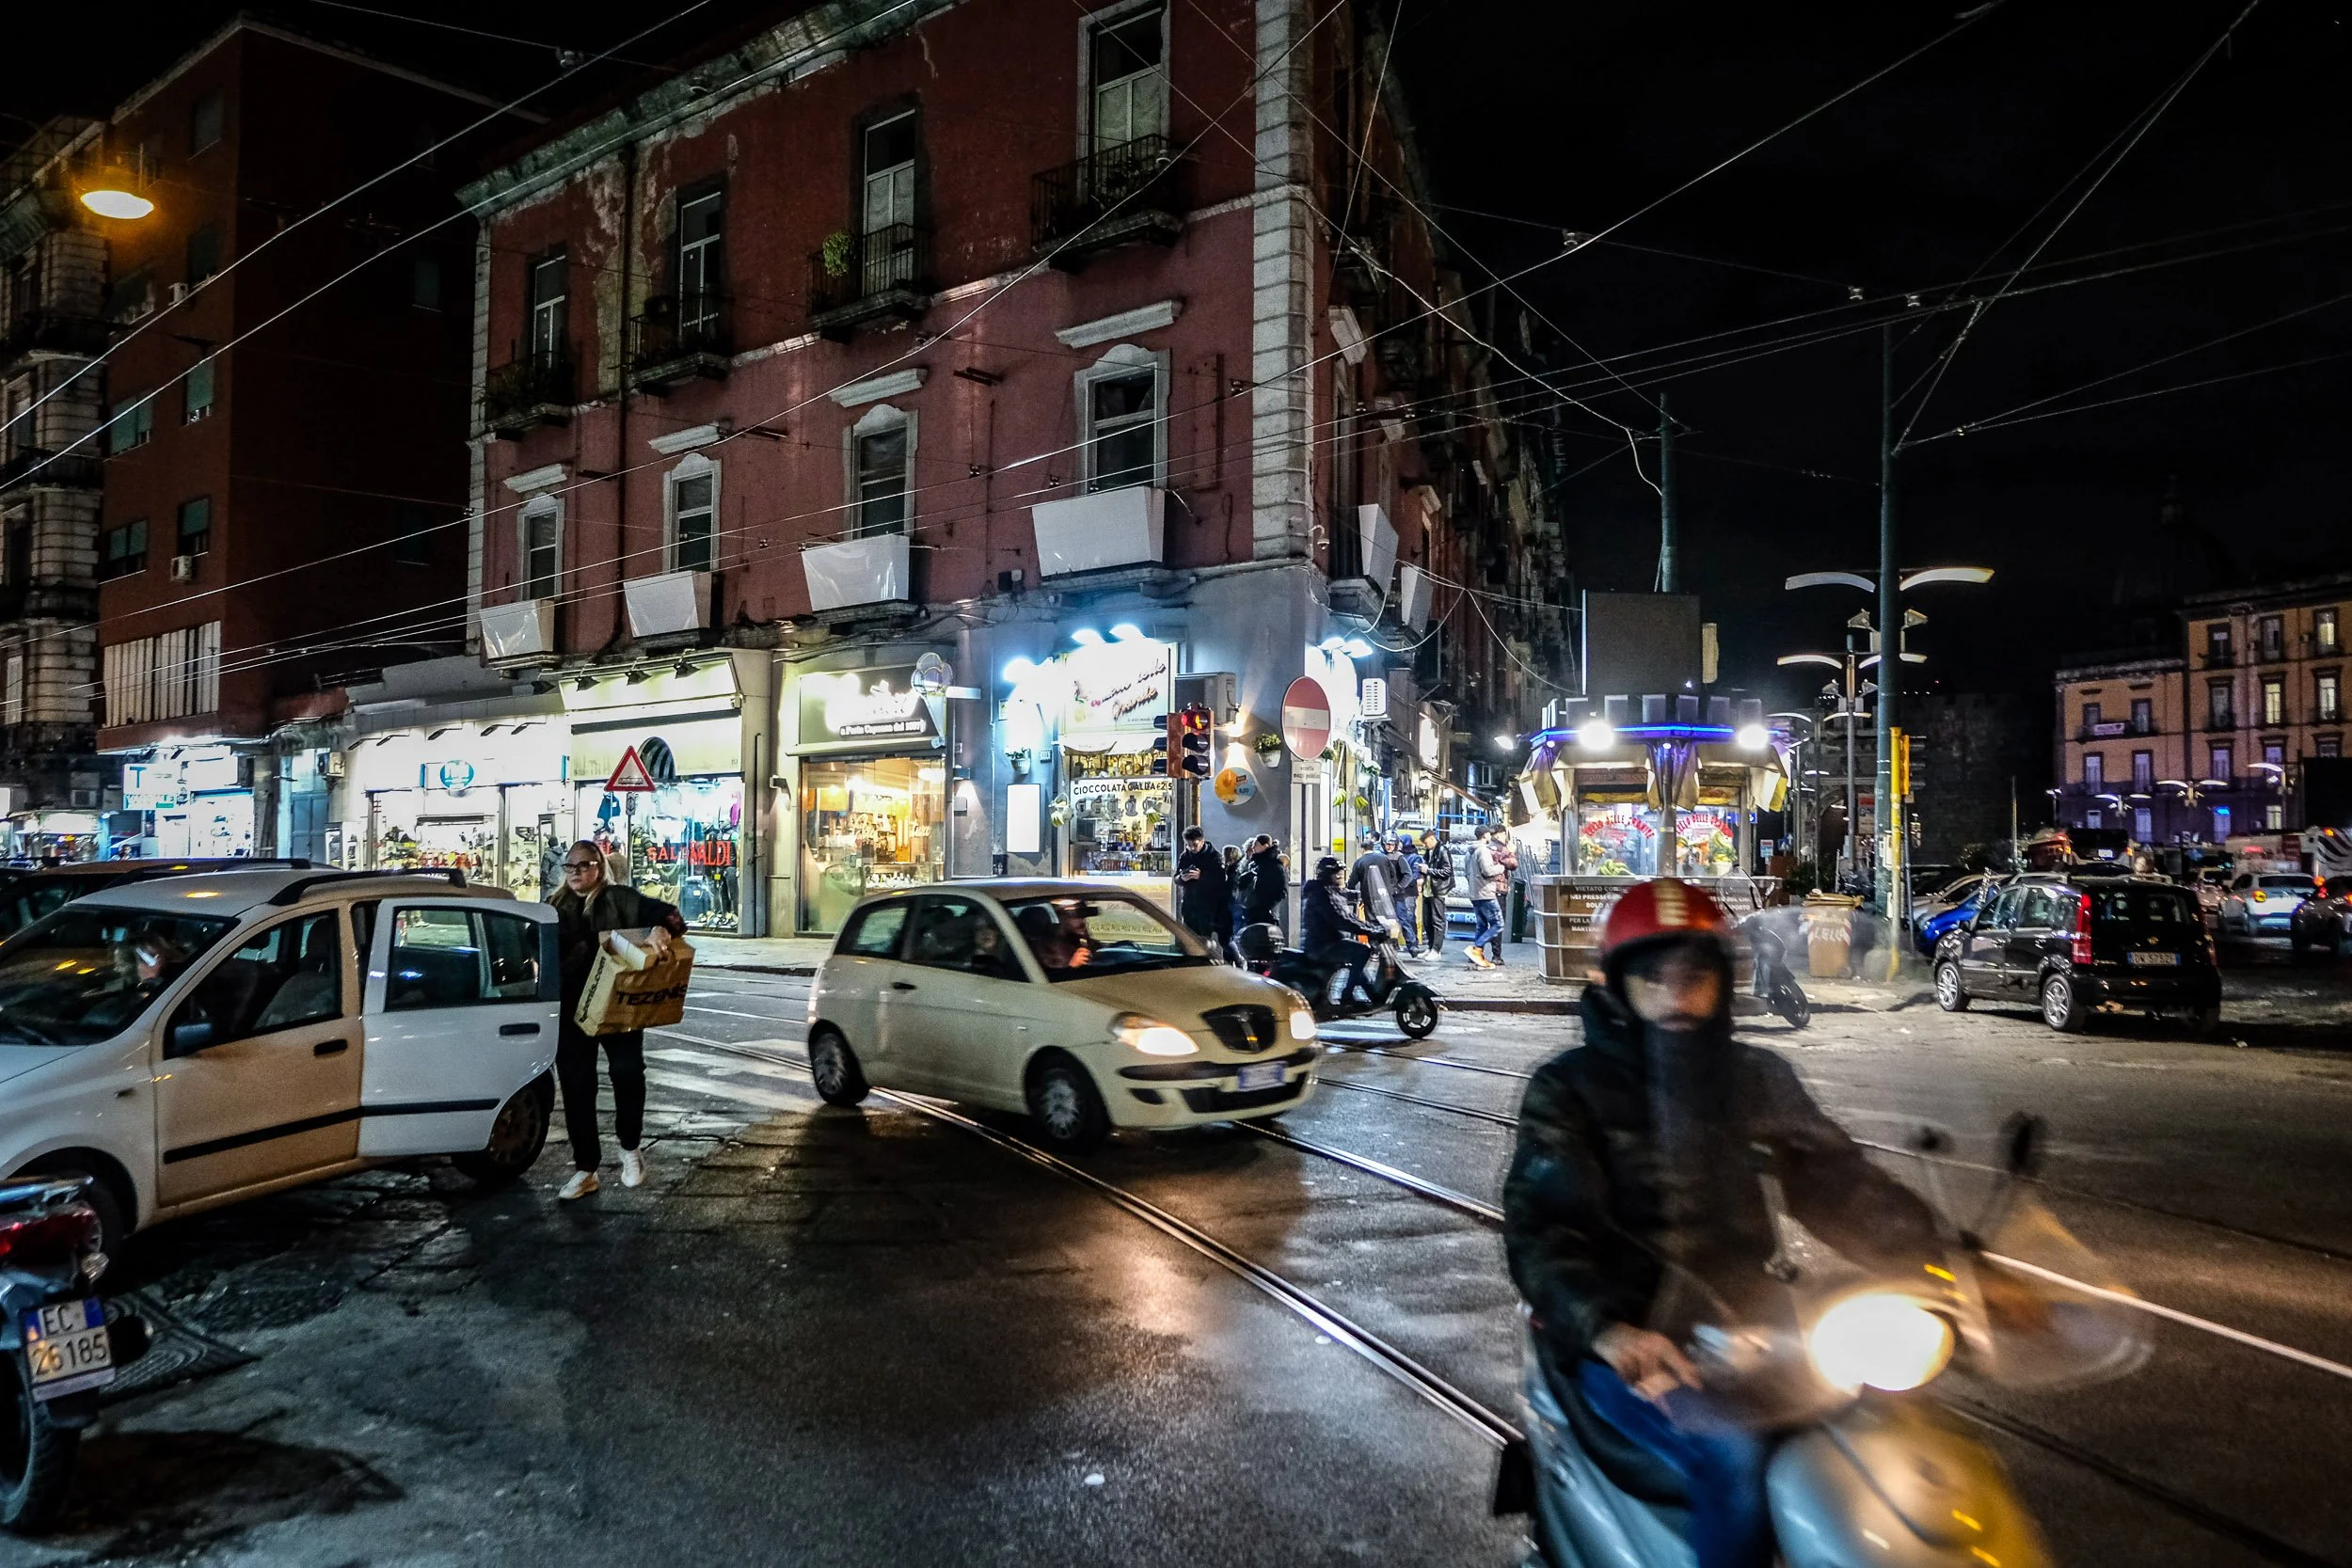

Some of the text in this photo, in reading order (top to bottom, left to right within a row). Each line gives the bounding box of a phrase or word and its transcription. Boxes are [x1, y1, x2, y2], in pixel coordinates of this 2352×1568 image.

[1073, 784, 1126, 796] CIOCCOLATA
[690, 840, 731, 866] SALDI
[42, 1305, 73, 1335] EC
[31, 1333, 107, 1376] 26185
